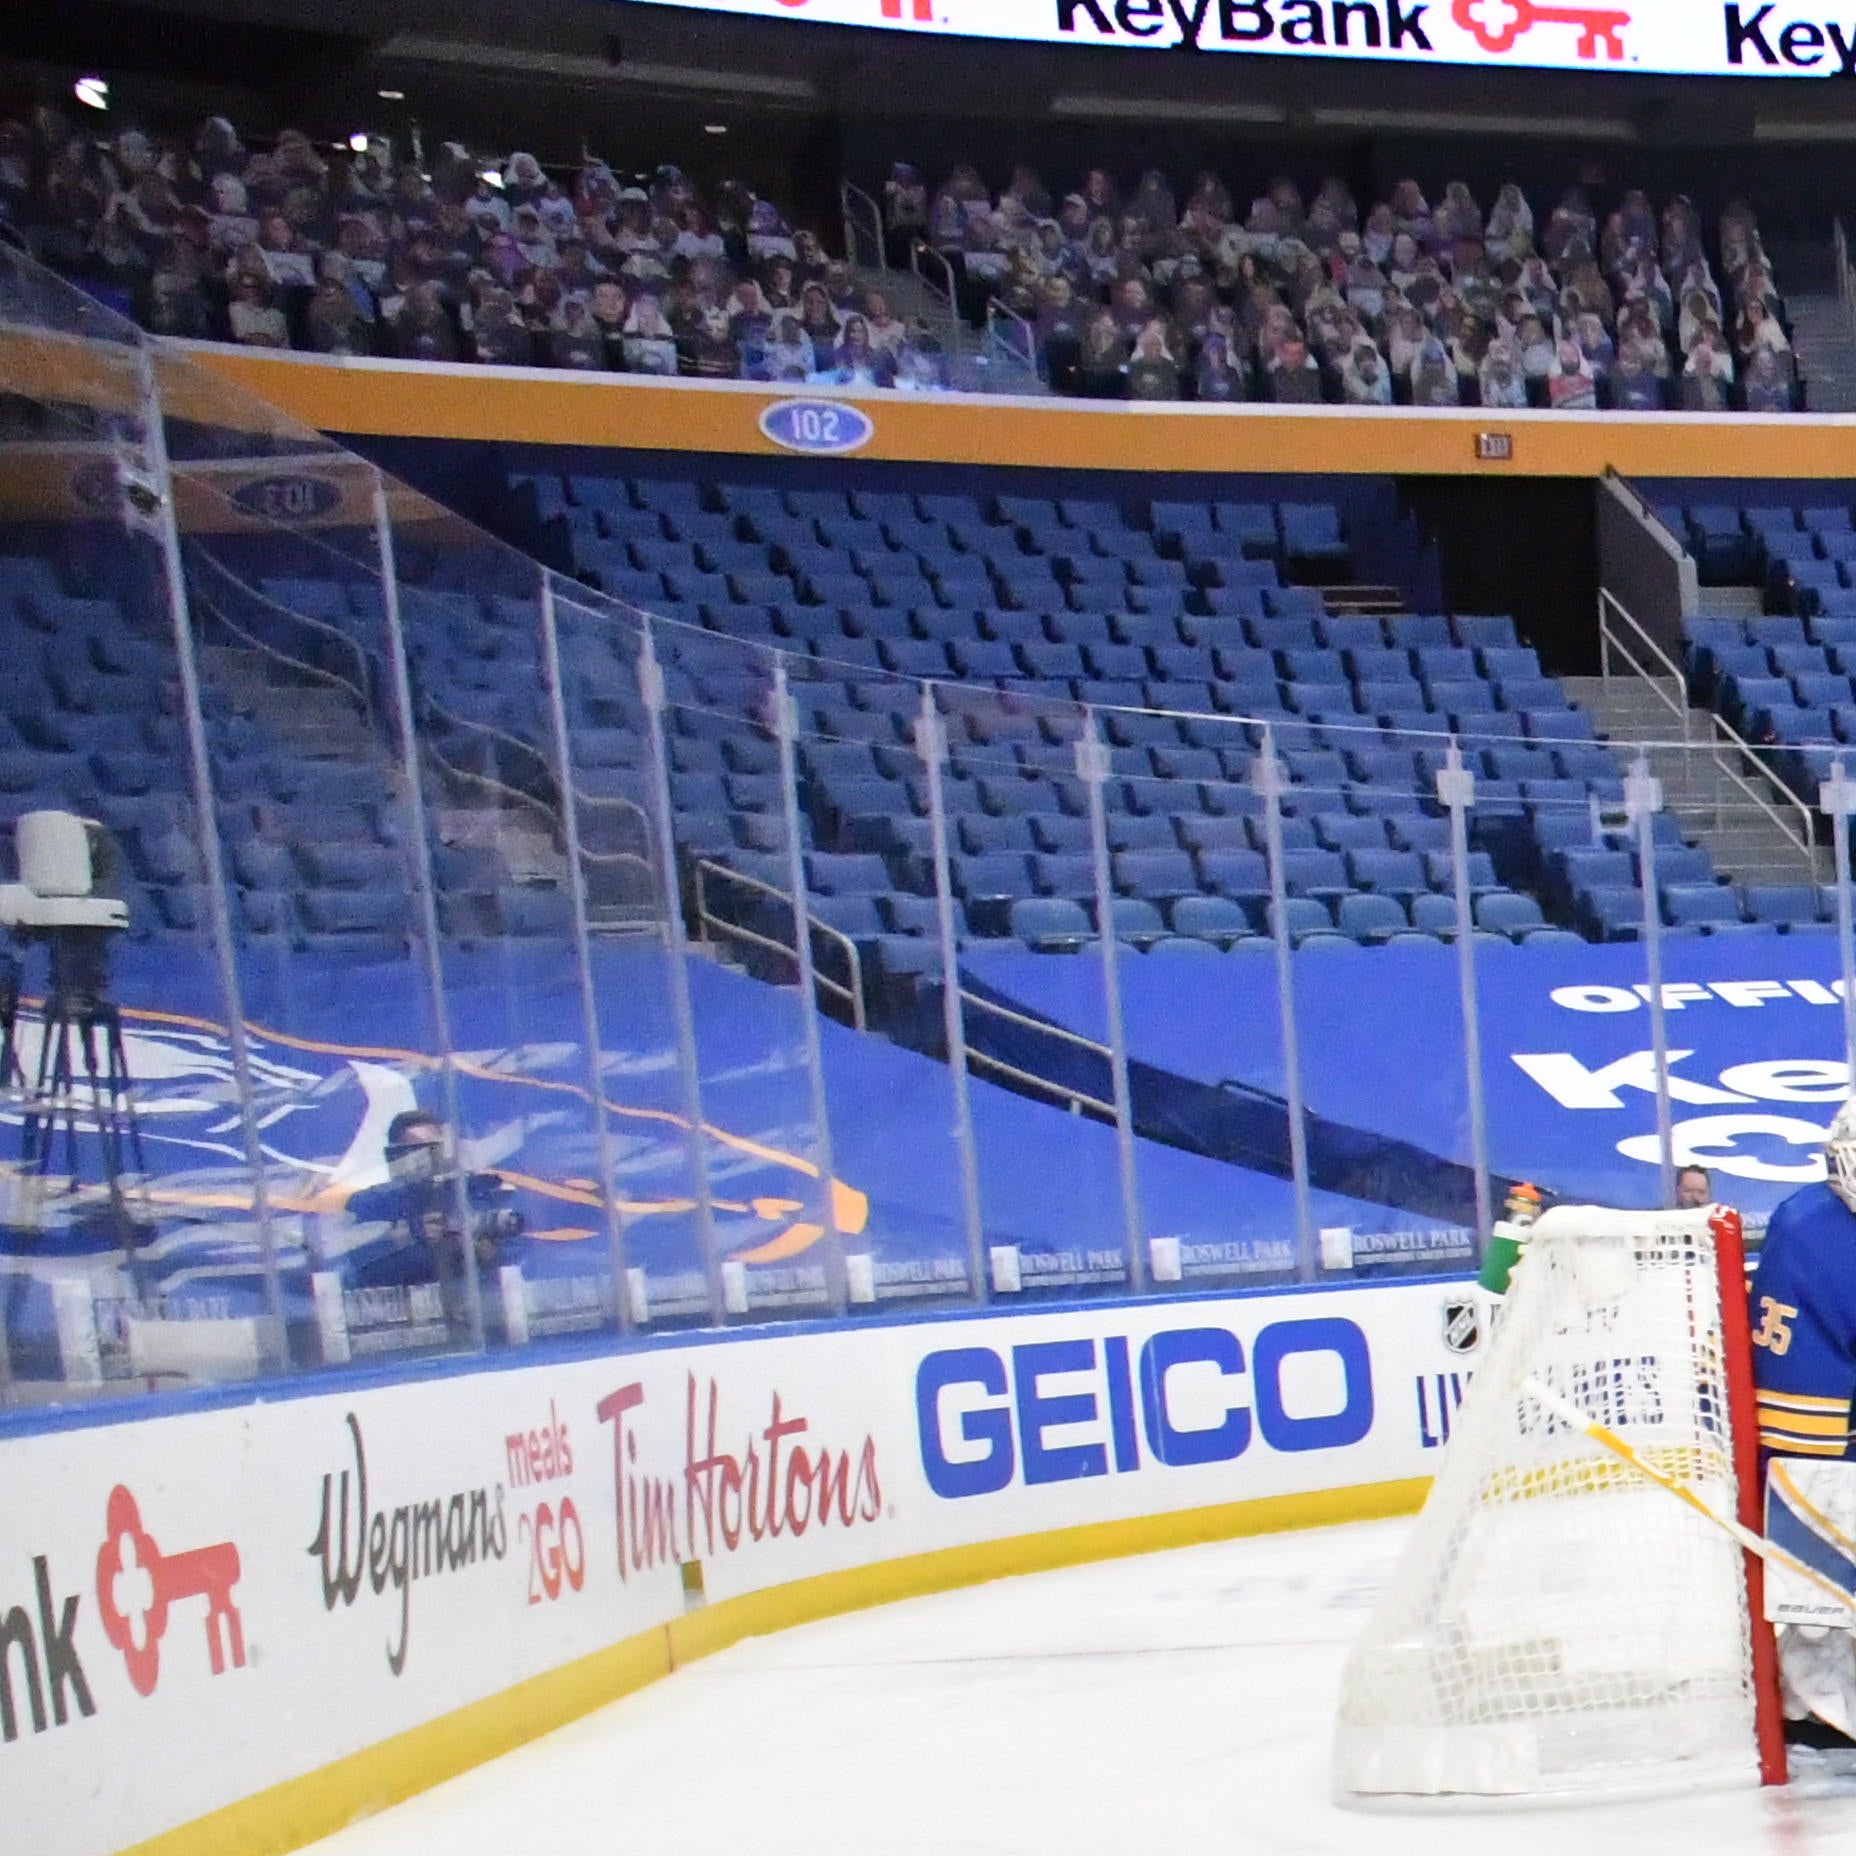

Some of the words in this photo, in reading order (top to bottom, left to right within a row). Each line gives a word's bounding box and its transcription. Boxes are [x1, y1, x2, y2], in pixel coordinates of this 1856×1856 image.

[1057, 0, 1433, 50] KeyBank
[790, 407, 841, 442] 102
[1431, 1227, 1471, 1247] PARK
[1750, 1295, 1798, 1357] 35
[506, 1398, 574, 1489] meals
[914, 1316, 1376, 1500] GEICO
[306, 1411, 508, 1677] Wegmans
[517, 1495, 585, 1606] 2GO
